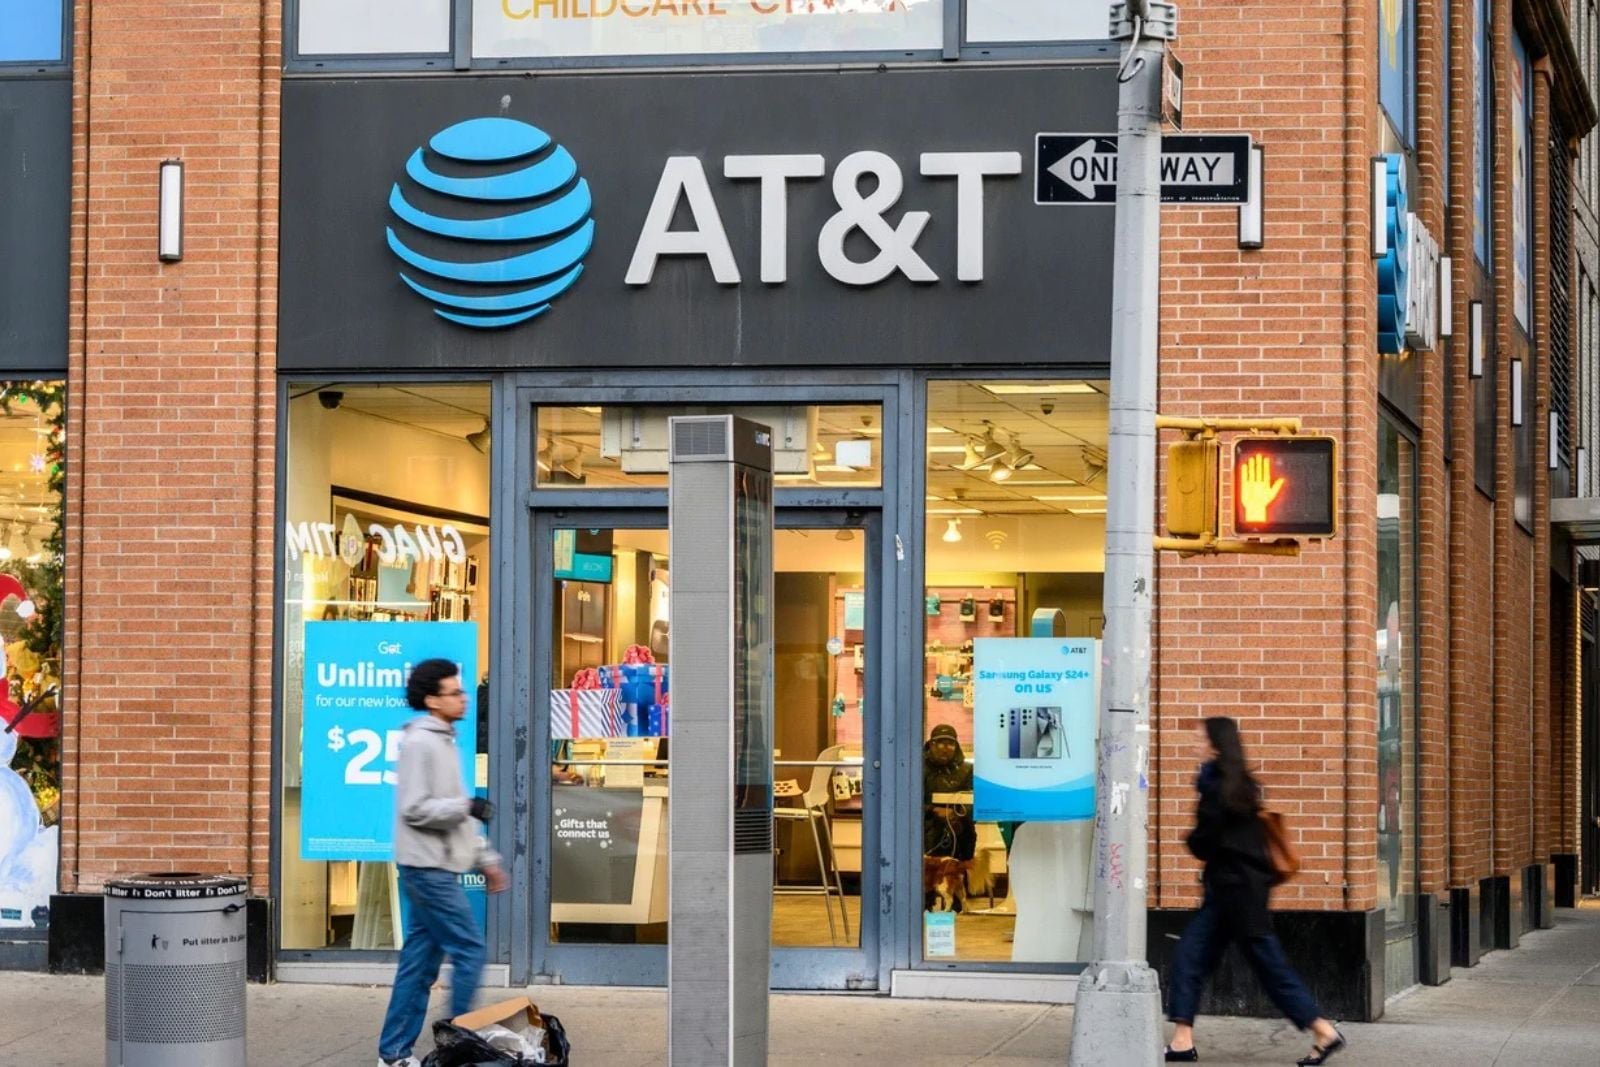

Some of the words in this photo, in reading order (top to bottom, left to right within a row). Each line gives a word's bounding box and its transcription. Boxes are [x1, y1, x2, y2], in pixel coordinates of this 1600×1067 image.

[1161, 157, 1221, 182] WAY
[624, 150, 1022, 285] AT&T
[377, 641, 402, 655] Get
[1028, 669, 1062, 681] Galaxy
[1065, 670, 1089, 679] S24+
[1014, 683, 1032, 693] on
[1035, 683, 1052, 693] us
[315, 695, 332, 707] for
[336, 697, 355, 707] our
[358, 697, 383, 707] new
[386, 695, 408, 707] low
[560, 819, 584, 829] Gifts
[586, 819, 607, 829] that
[557, 829, 597, 838] connect
[598, 830, 610, 838] us
[144, 889, 172, 898] Don't
[176, 888, 200, 897] litter
